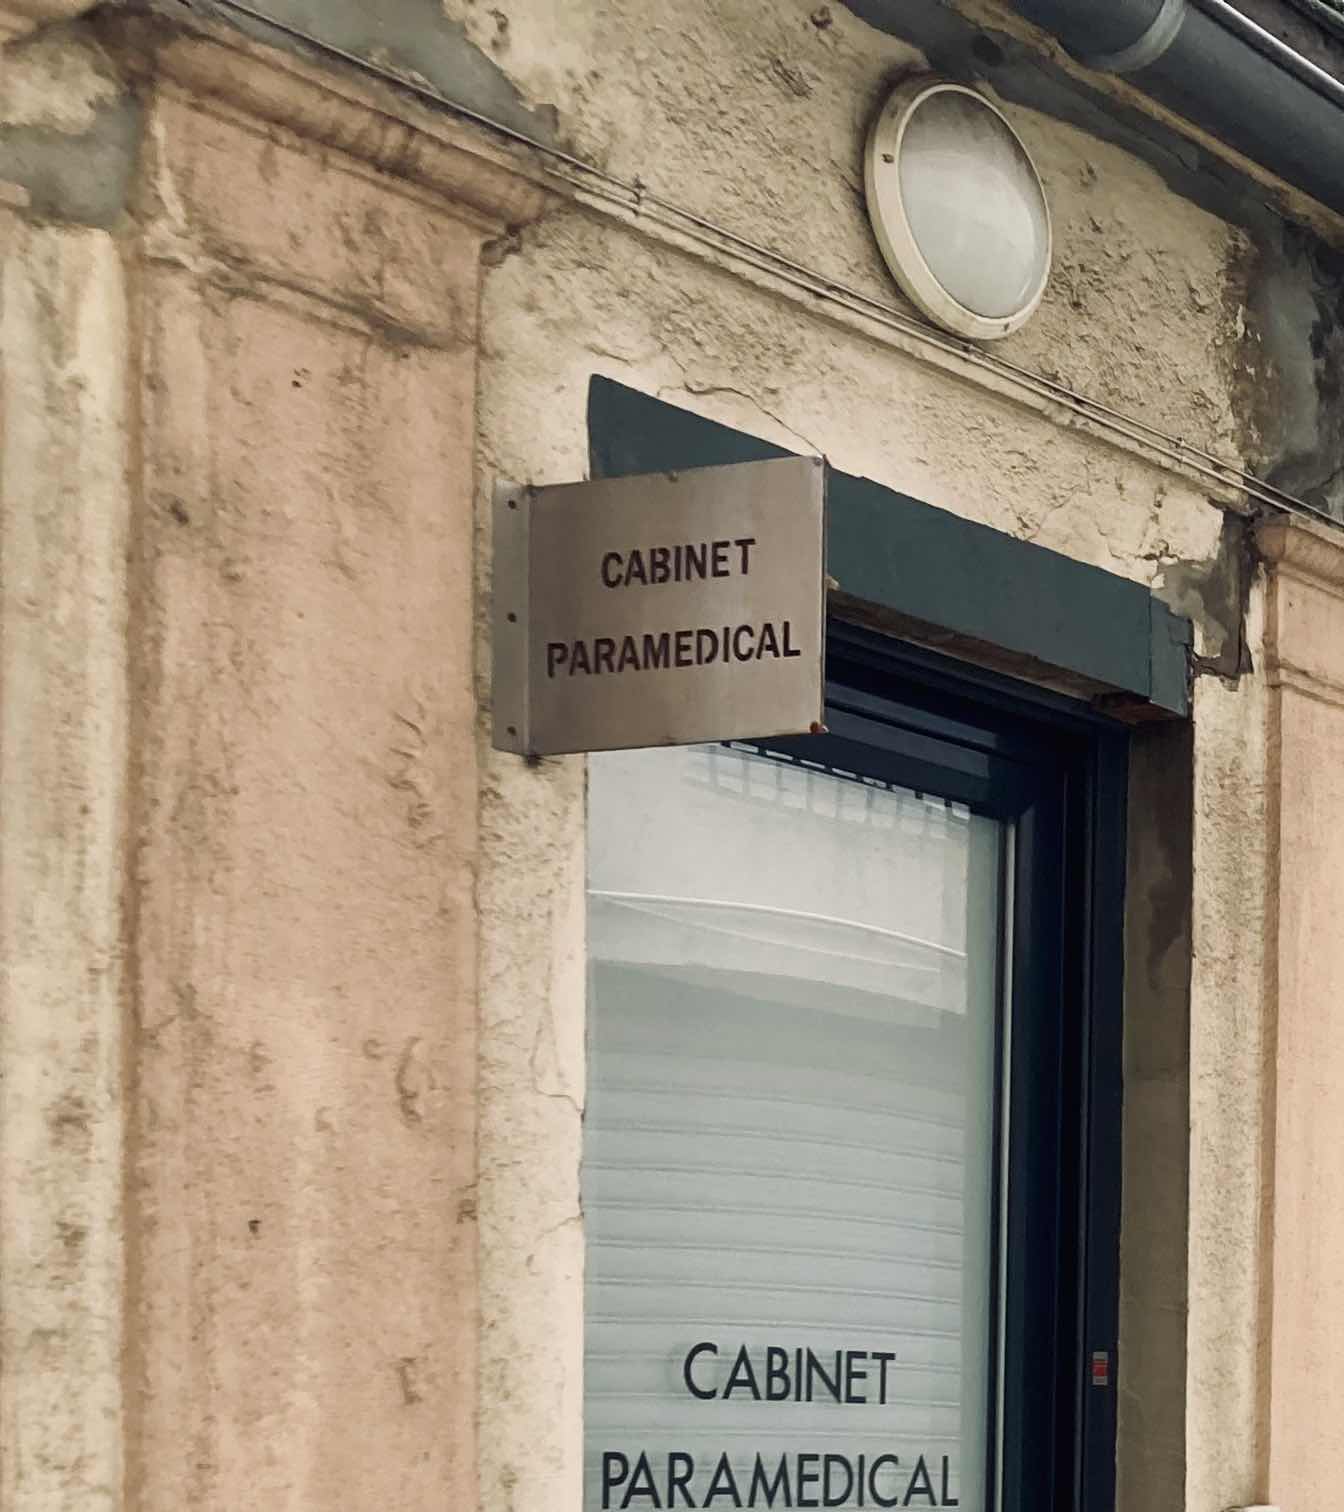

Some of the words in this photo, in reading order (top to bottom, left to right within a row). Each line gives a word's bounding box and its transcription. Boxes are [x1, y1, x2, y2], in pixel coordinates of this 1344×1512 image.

[601, 538, 756, 588] CABINET
[546, 621, 801, 679] PARAMEDICAL
[683, 1342, 896, 1404] CABINET
[601, 1450, 959, 1510] PARAMEDICAL
